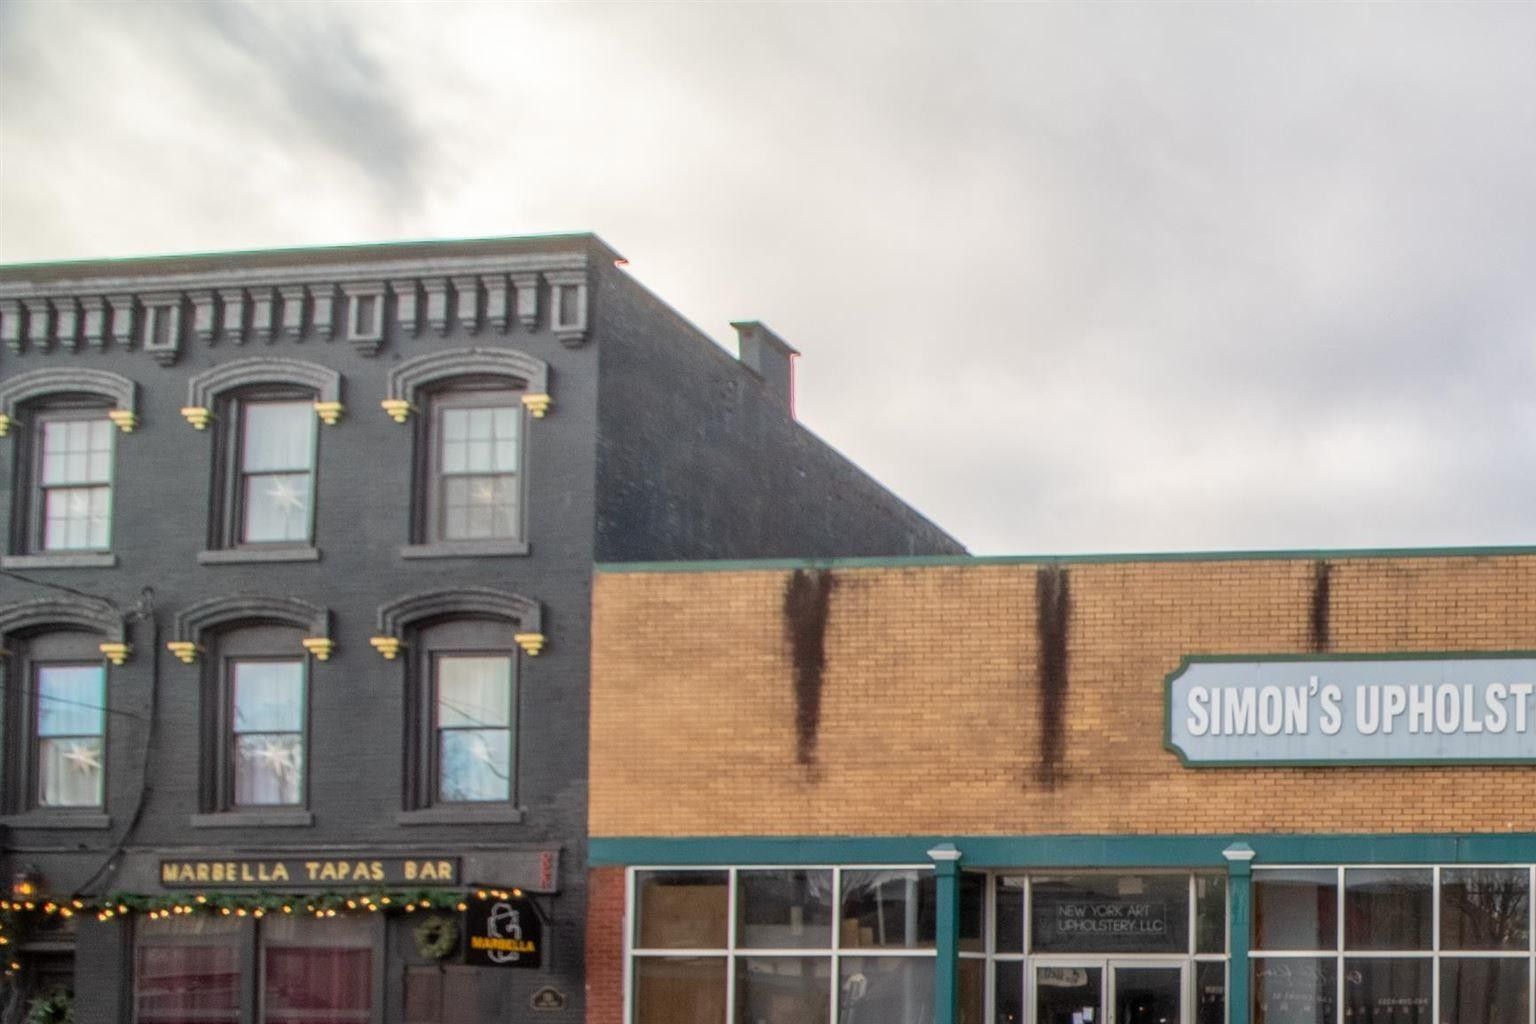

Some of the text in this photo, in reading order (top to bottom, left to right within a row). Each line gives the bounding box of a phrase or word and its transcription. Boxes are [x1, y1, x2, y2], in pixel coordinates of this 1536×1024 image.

[1186, 675, 1342, 736] SIMON'S
[162, 860, 454, 882] MARBELLA TAPAS BAR
[1058, 904, 1151, 917] NEW YORK ART
[1058, 919, 1163, 931] UPHOLSTERY LLC
